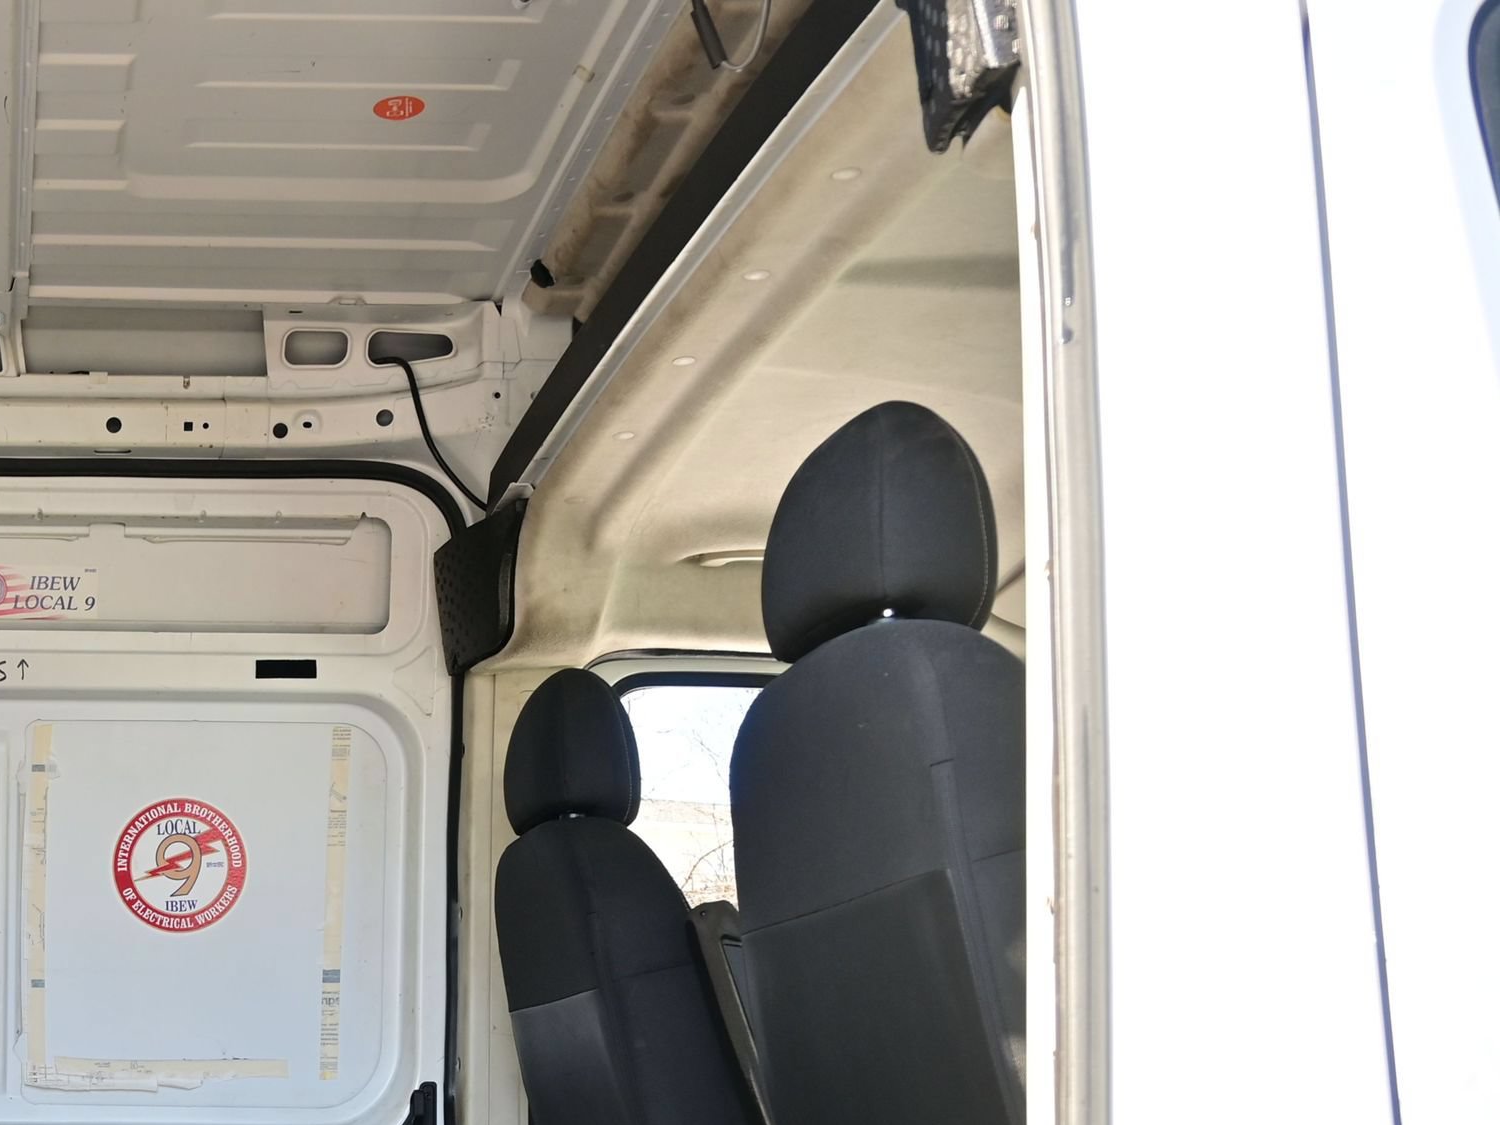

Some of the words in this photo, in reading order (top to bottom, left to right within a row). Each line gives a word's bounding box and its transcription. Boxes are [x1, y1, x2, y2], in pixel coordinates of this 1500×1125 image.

[29, 575, 81, 591] IBEW
[13, 594, 79, 611] LOCAL
[84, 595, 96, 612] 9
[156, 819, 200, 835] LOCAL
[117, 802, 181, 872] INTERNATIONAL
[184, 802, 242, 868] BROTHERHOOD
[155, 834, 203, 898] 9
[122, 887, 137, 901] OF
[131, 900, 194, 929] ELECTRICAL
[195, 884, 238, 925] WORKERS
[165, 899, 198, 912] IBEW
